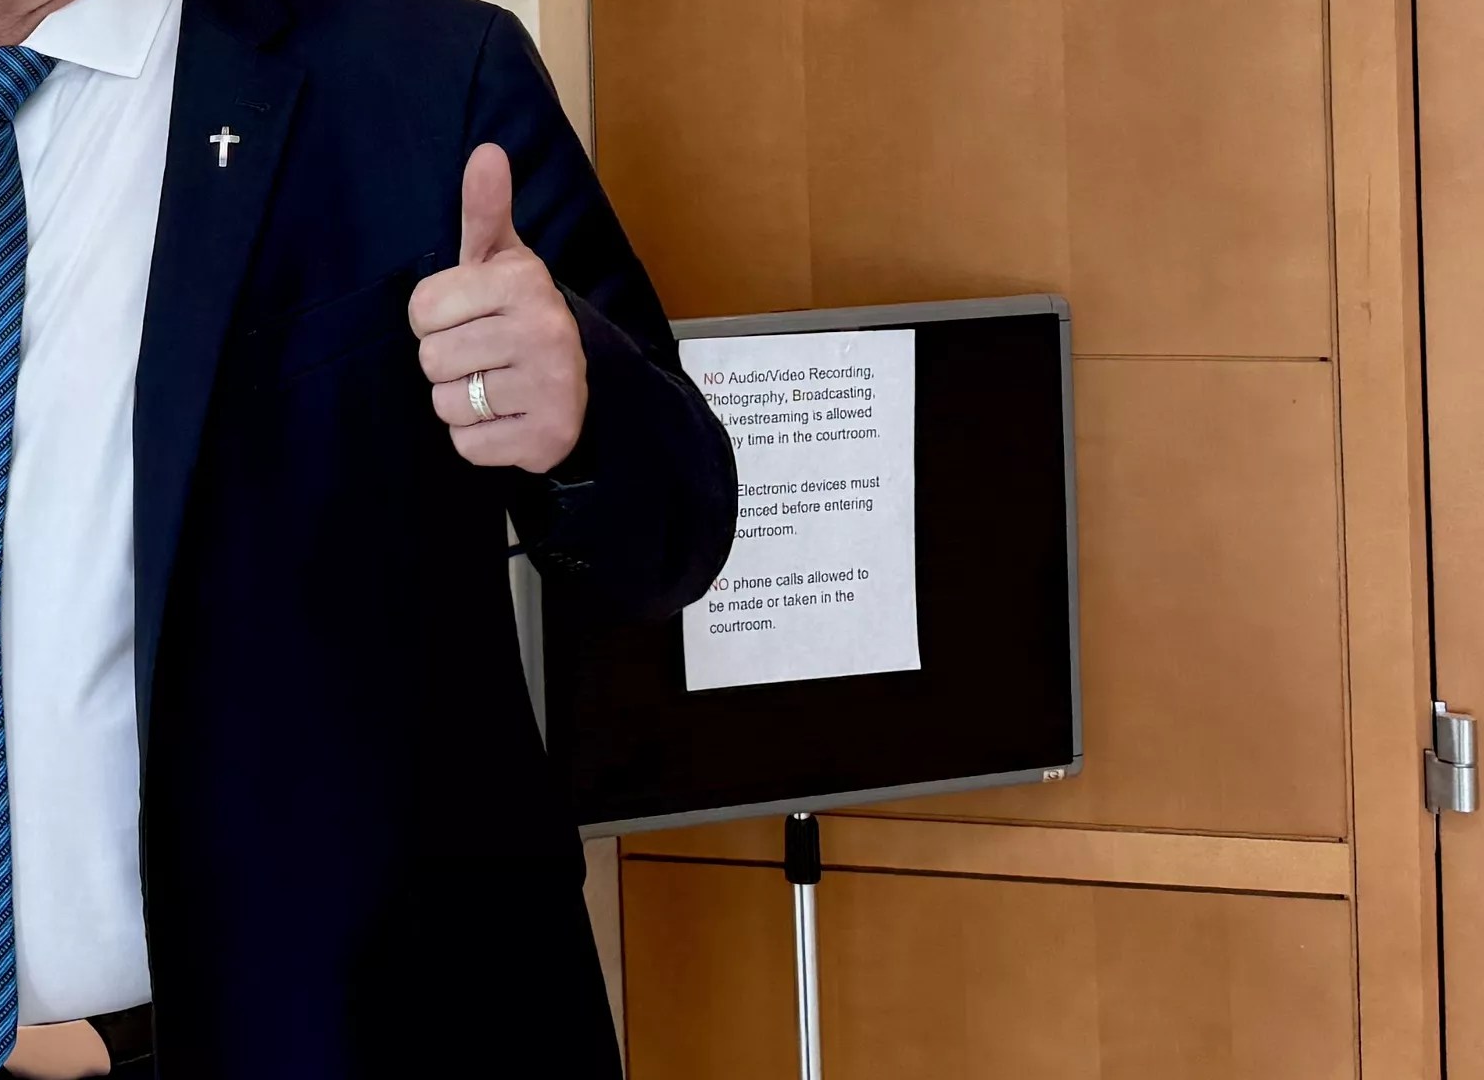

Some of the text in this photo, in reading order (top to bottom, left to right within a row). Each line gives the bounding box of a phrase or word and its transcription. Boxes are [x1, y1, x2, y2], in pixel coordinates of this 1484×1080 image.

[704, 366, 874, 385] NO Audio/Video Recording,
[793, 386, 875, 402] Broadcasting,
[721, 406, 872, 426] Livestreaming is allowed
[731, 427, 880, 449] ny time in the courtroom.
[737, 476, 880, 497] Electronic devices must
[740, 498, 873, 518] enced before entering
[733, 577, 772, 592] phone
[776, 573, 803, 587] calls
[807, 569, 854, 583] allowed
[857, 568, 869, 579] to
[709, 590, 854, 613] be made or taken in the
[710, 619, 776, 634] courtroom.
